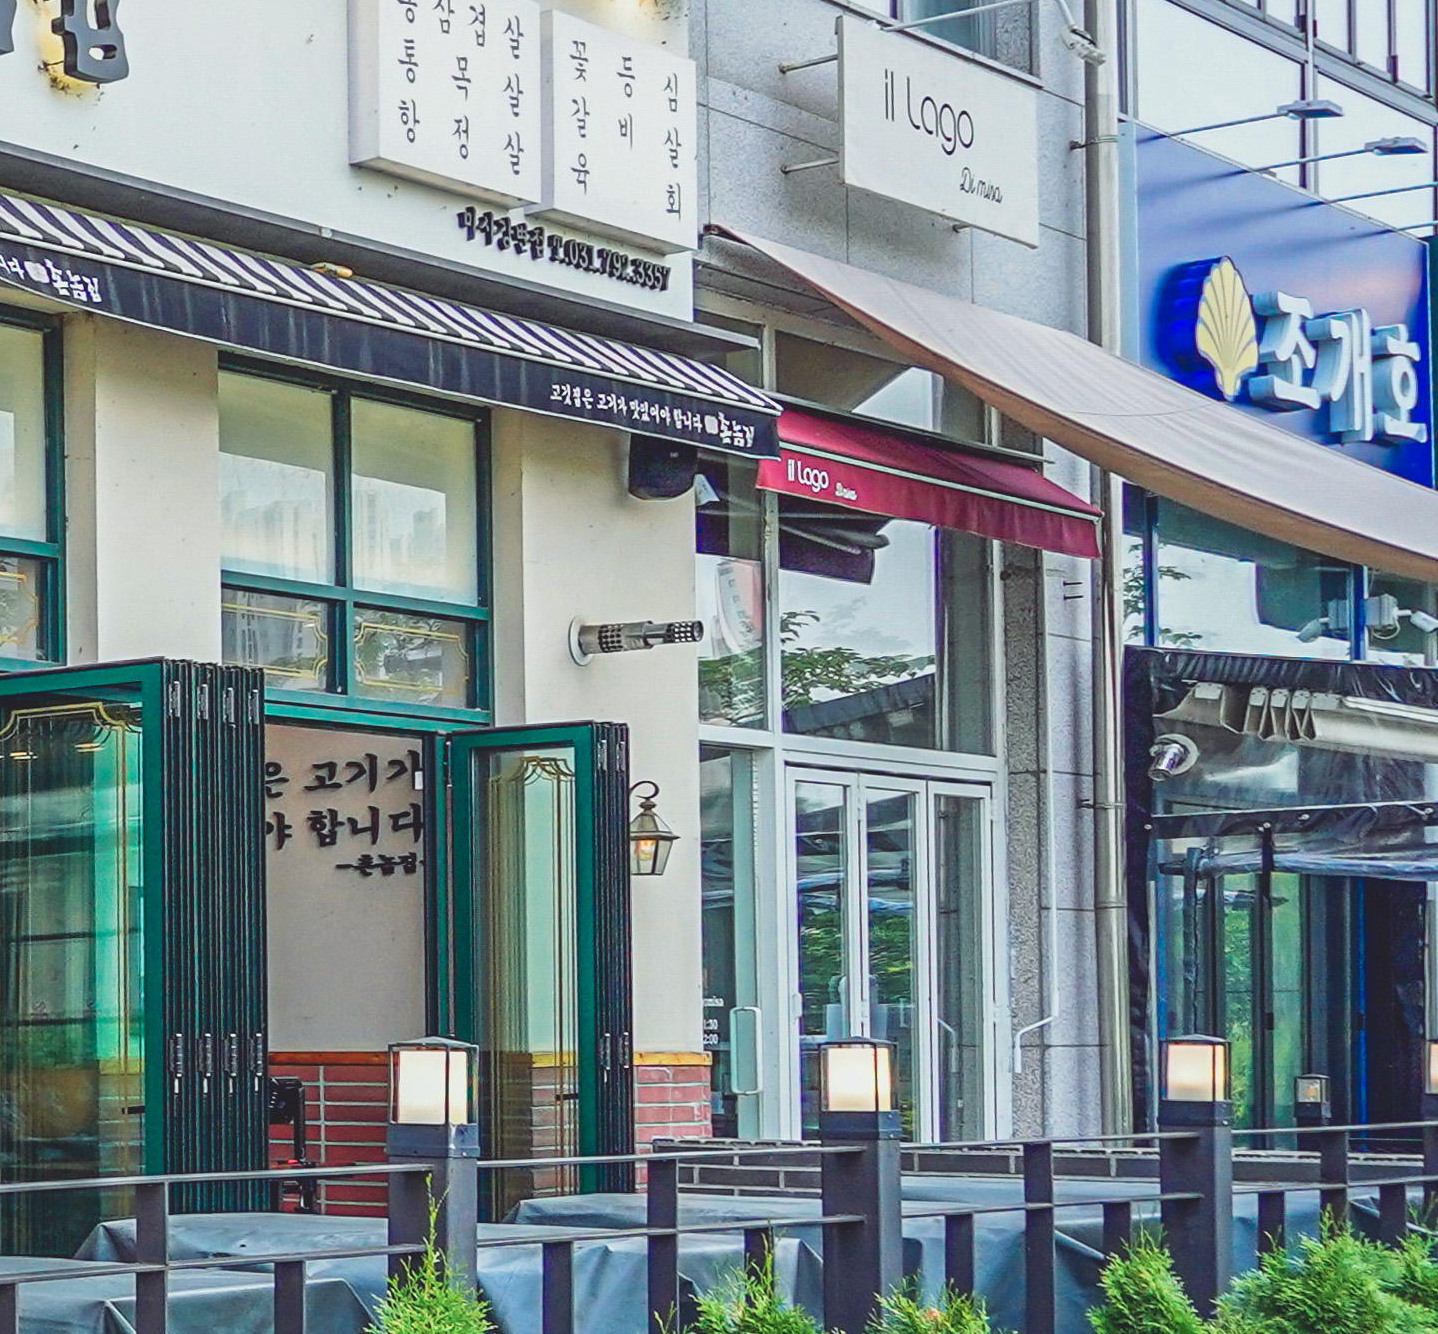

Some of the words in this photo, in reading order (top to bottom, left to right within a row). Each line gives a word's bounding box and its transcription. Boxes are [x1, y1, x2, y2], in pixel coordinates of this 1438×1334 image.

[457, 206, 545, 261] 미사강변점
[44, 258, 102, 303] 촌놈집
[550, 383, 593, 410] 고깃집은
[596, 393, 628, 416] 고기가
[629, 400, 671, 427] 맛있어야
[719, 412, 756, 449] 촌놈집
[307, 803, 424, 847] 합니다
